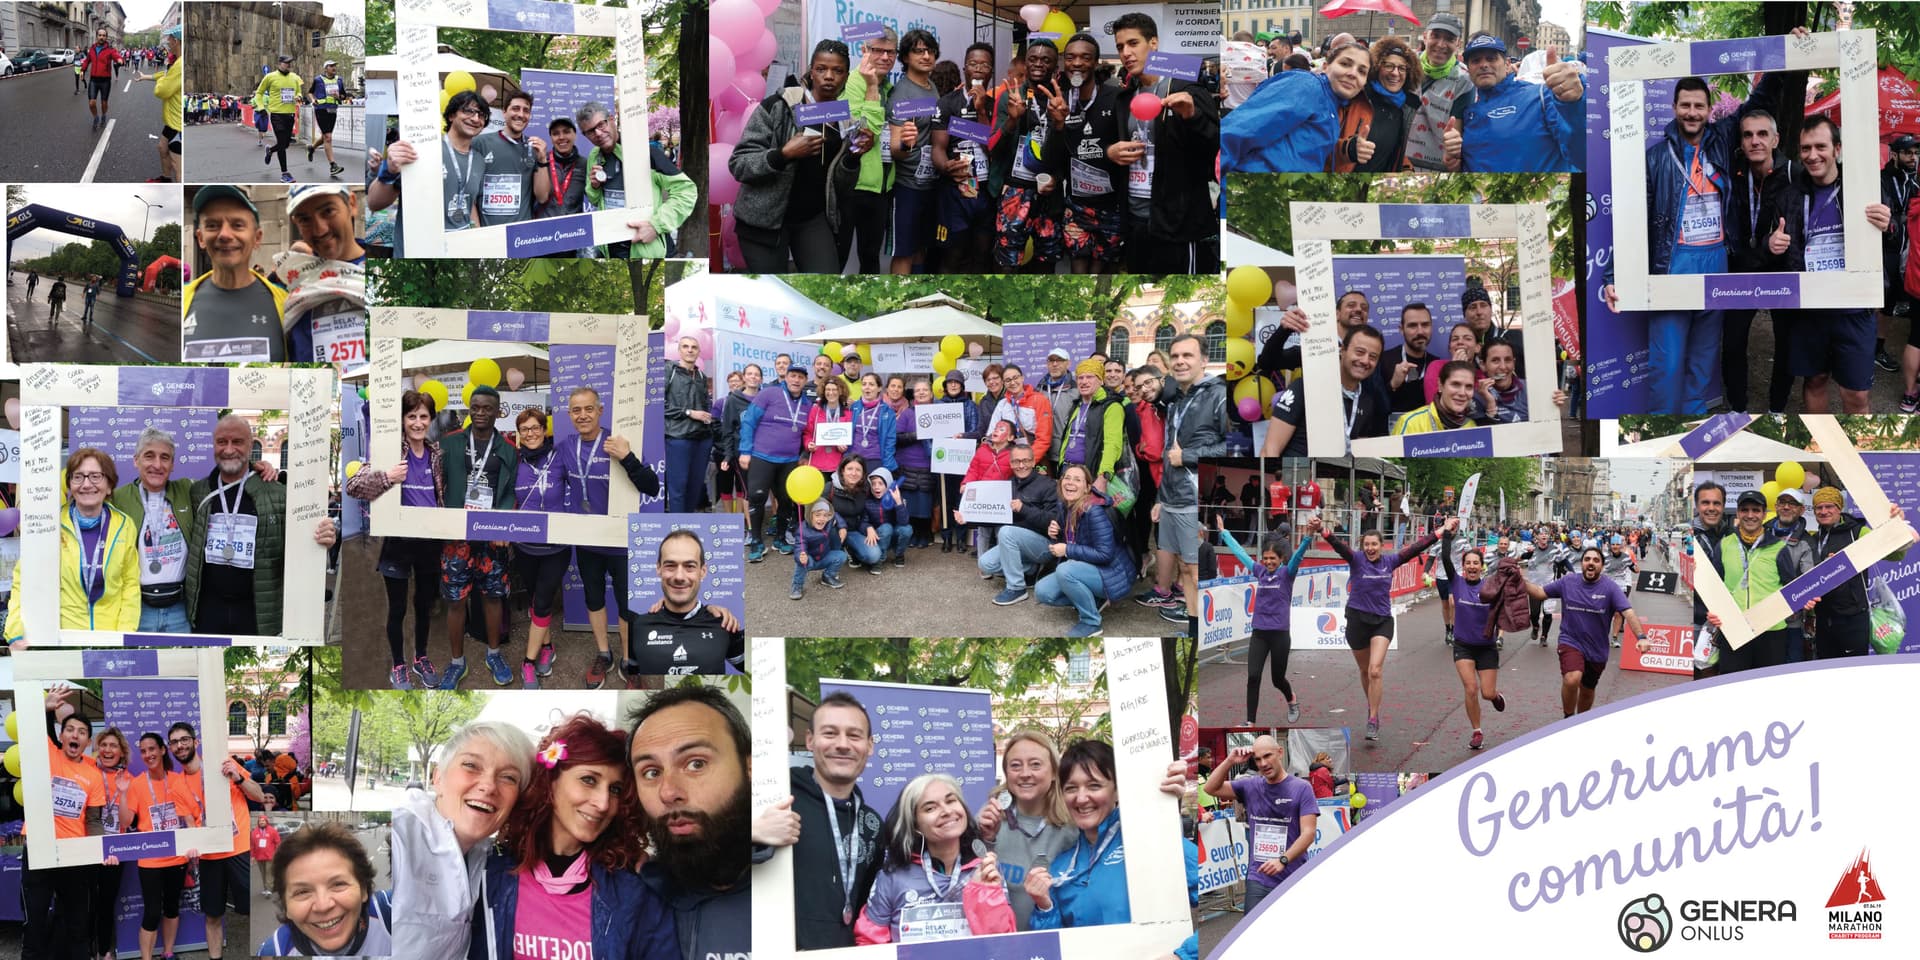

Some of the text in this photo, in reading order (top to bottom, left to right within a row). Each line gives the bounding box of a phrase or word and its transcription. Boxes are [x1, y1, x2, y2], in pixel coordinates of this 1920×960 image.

[490, 194, 513, 203] 2570D
[18, 210, 32, 221] GLS
[82, 218, 96, 228] GLS
[1691, 217, 1717, 229] 2569A
[1817, 259, 1846, 272] 2569B
[1712, 287, 1753, 298] Generiamo
[733, 342, 778, 361] Ricerca
[933, 412, 961, 420] GENERA
[473, 522, 508, 531] Generiamo
[1215, 607, 1233, 622] europ
[1204, 626, 1233, 645] assistance
[1642, 656, 1662, 665] ORA
[1120, 694, 1149, 712] AGIRE
[55, 797, 76, 809] 2573A
[1211, 842, 1244, 863] europ
[1258, 843, 1278, 853] 2569D
[925, 924, 948, 932] RELAY
